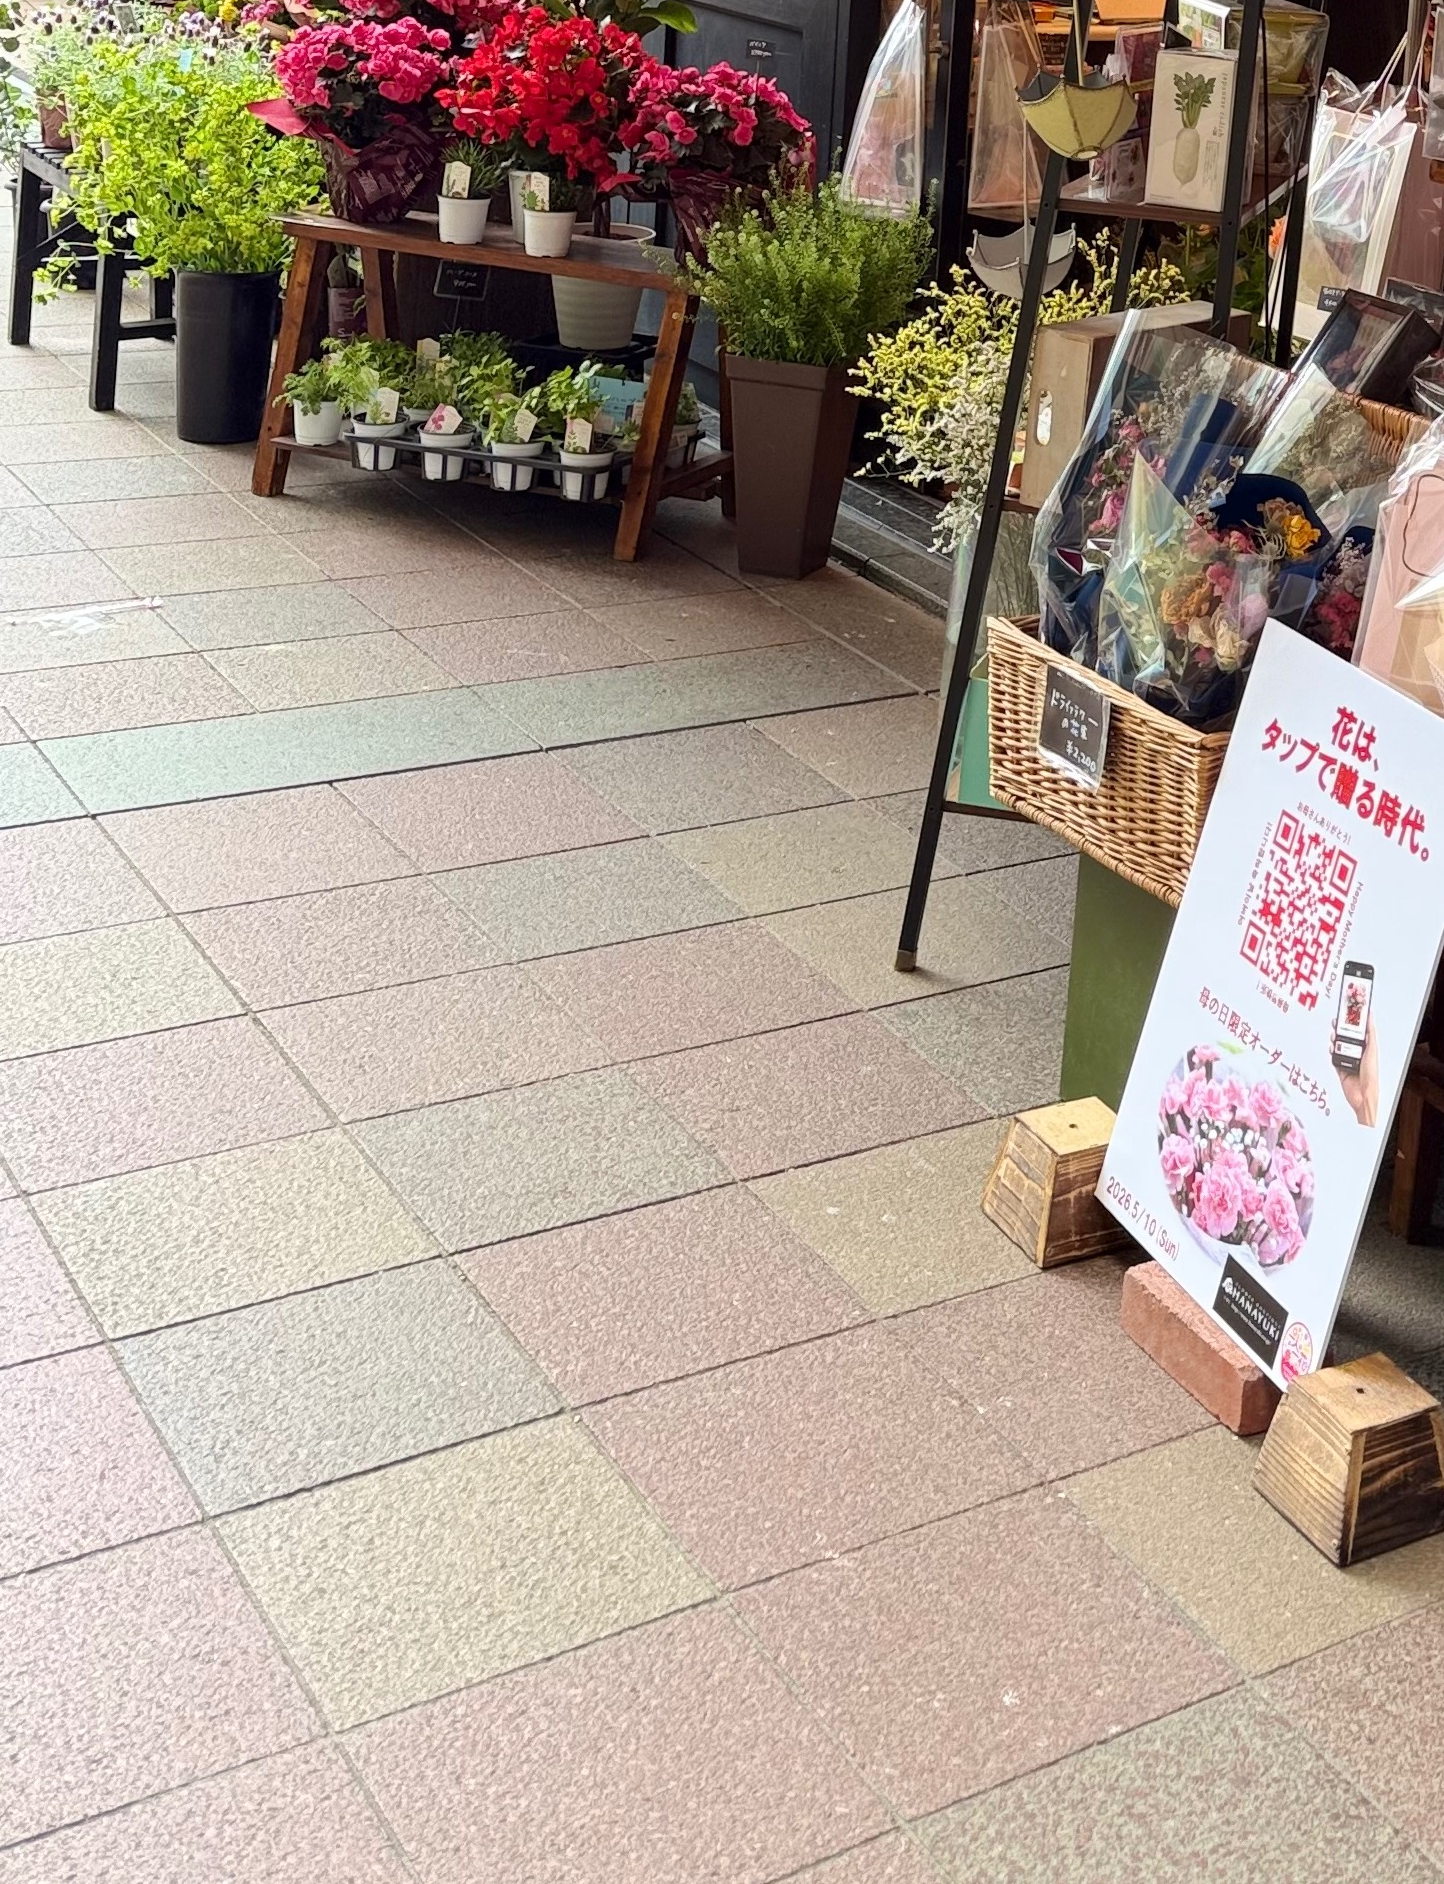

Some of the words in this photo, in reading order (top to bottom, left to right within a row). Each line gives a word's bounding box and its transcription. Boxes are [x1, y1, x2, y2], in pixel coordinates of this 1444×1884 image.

[1065, 739, 1097, 773] ¥2,200
[1331, 706, 1380, 772] 花は、
[1261, 717, 1430, 863] タップで贈る時代。
[1199, 986, 1331, 1117] 母の日限定オーダーはこちら。
[1231, 1288, 1281, 1343] HANAYUKI
